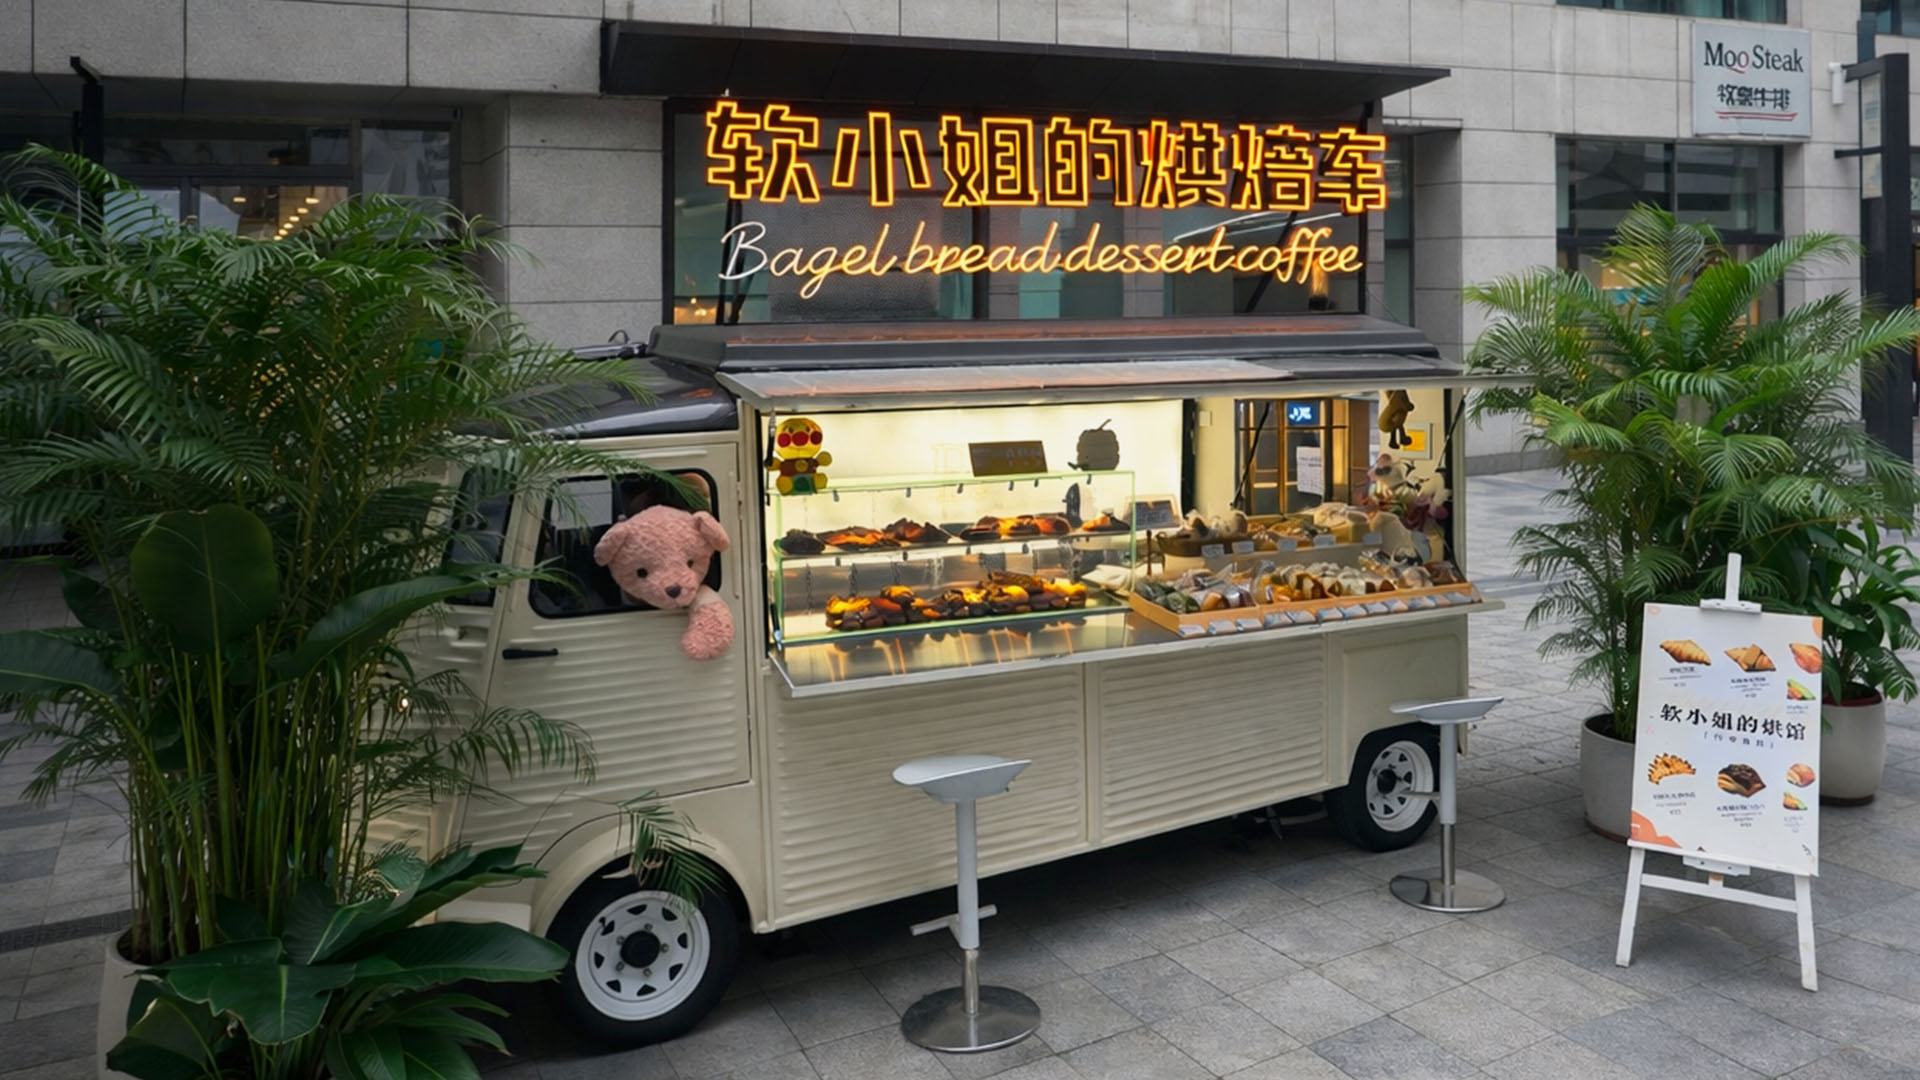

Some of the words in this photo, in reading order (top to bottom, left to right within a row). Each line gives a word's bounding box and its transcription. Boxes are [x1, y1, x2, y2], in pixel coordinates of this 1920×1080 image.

[1704, 40, 1749, 74] Moo
[1752, 44, 1804, 73] Steak
[706, 100, 1387, 213] 软小姐的烘焙车
[719, 221, 897, 299] Bagel
[902, 220, 1061, 275] bread
[1064, 222, 1235, 274] dessert
[1237, 226, 1363, 284] coffee
